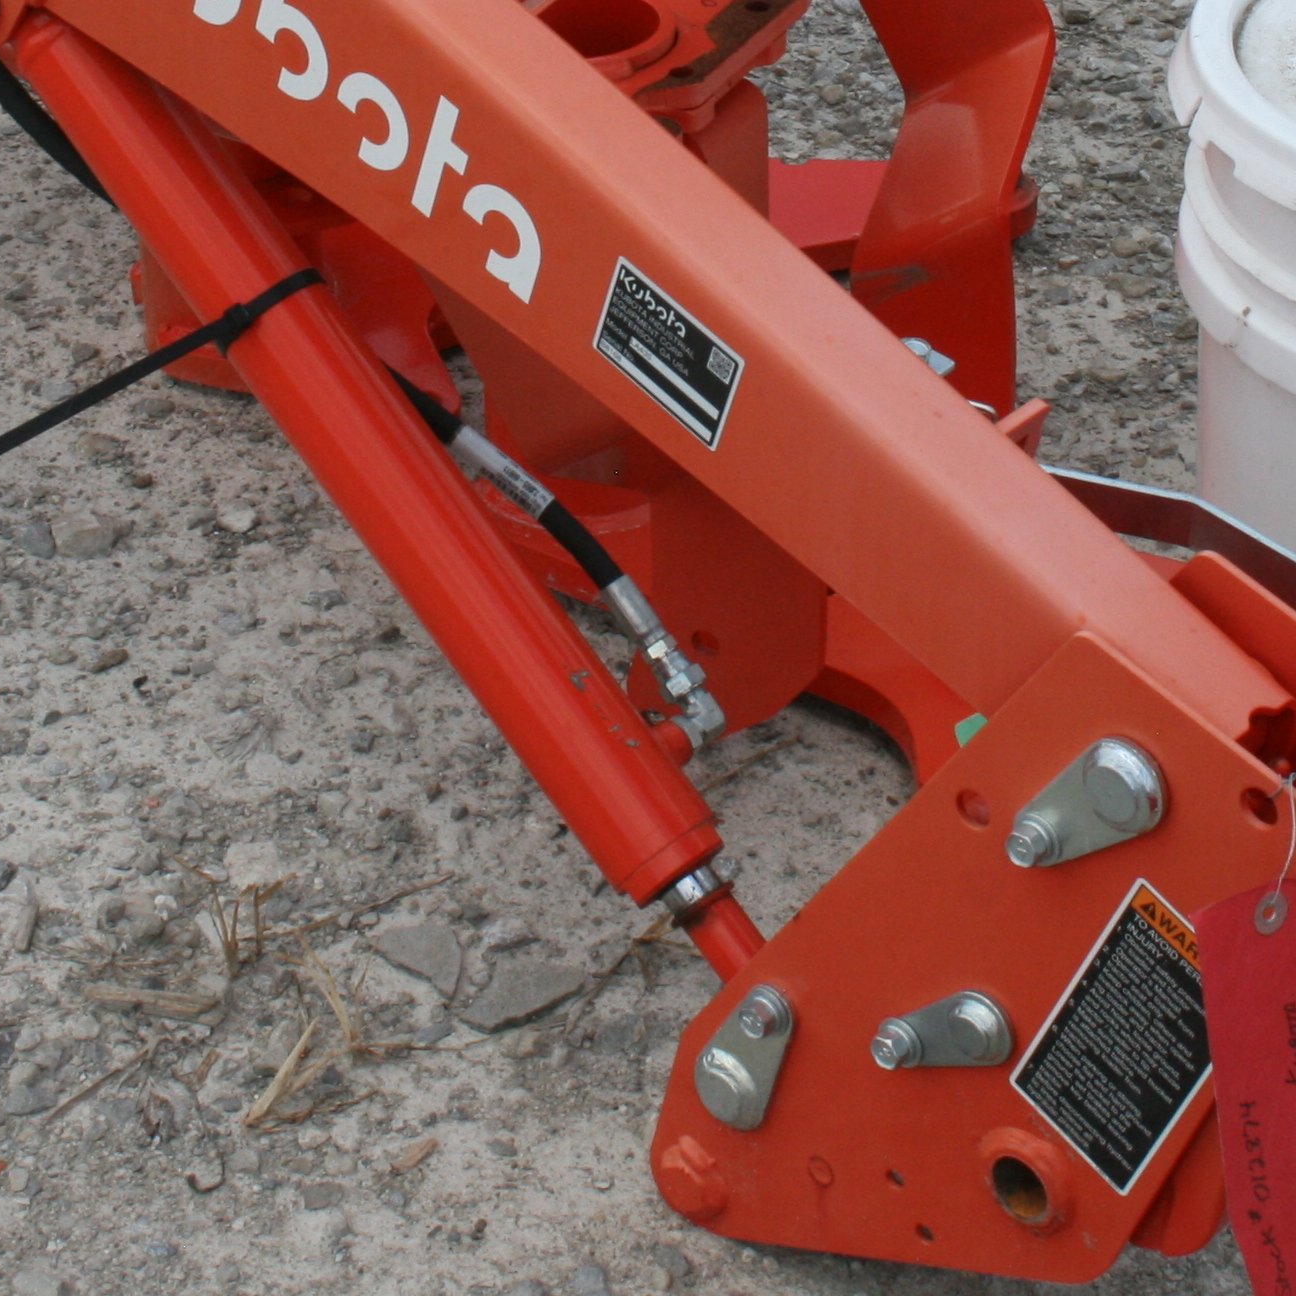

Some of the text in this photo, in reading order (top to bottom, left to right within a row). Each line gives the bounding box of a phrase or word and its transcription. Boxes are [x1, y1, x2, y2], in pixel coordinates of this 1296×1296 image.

[612, 294, 659, 339] EQUIPMENT
[614, 285, 648, 319] KUBOTA
[648, 314, 695, 359] INDUSTRIAL
[617, 267, 689, 339] Kubota
[671, 356, 689, 377] USA
[1126, 921, 1163, 961] INJURY
[1132, 912, 1148, 931] TO
[1147, 927, 1179, 962] AVOID
